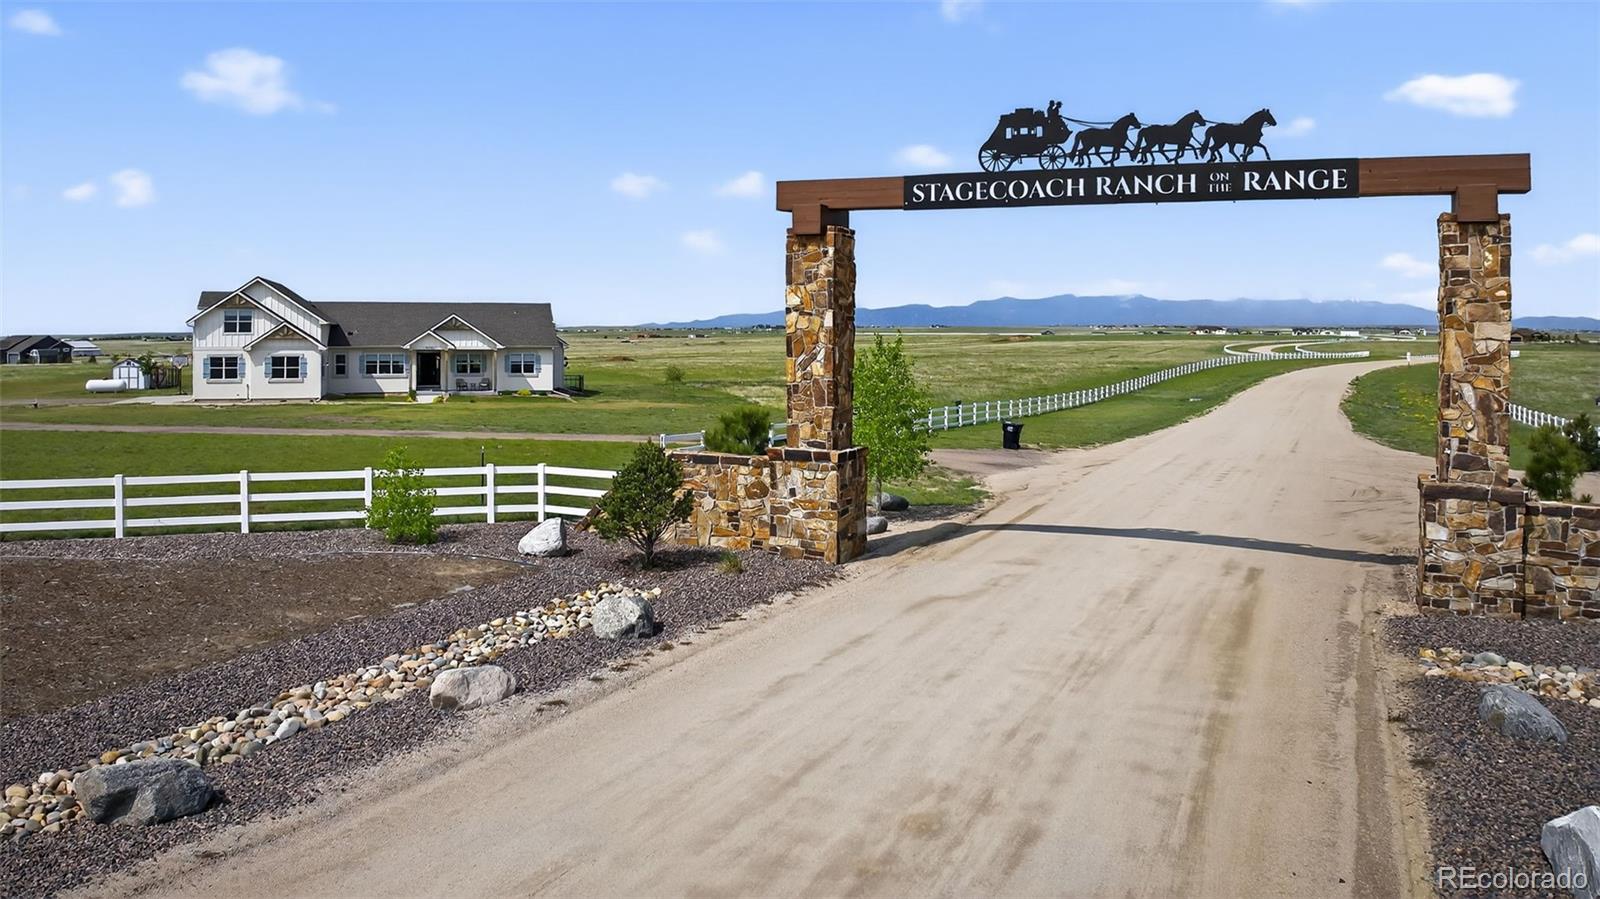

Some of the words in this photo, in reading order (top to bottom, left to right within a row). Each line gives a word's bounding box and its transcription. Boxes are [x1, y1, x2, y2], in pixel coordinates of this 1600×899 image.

[1209, 172, 1229, 182] ON
[1243, 168, 1348, 191] RANGE
[912, 178, 1085, 203] STAGECOACH
[1096, 173, 1196, 196] RANCH
[1207, 183, 1232, 193] THE
